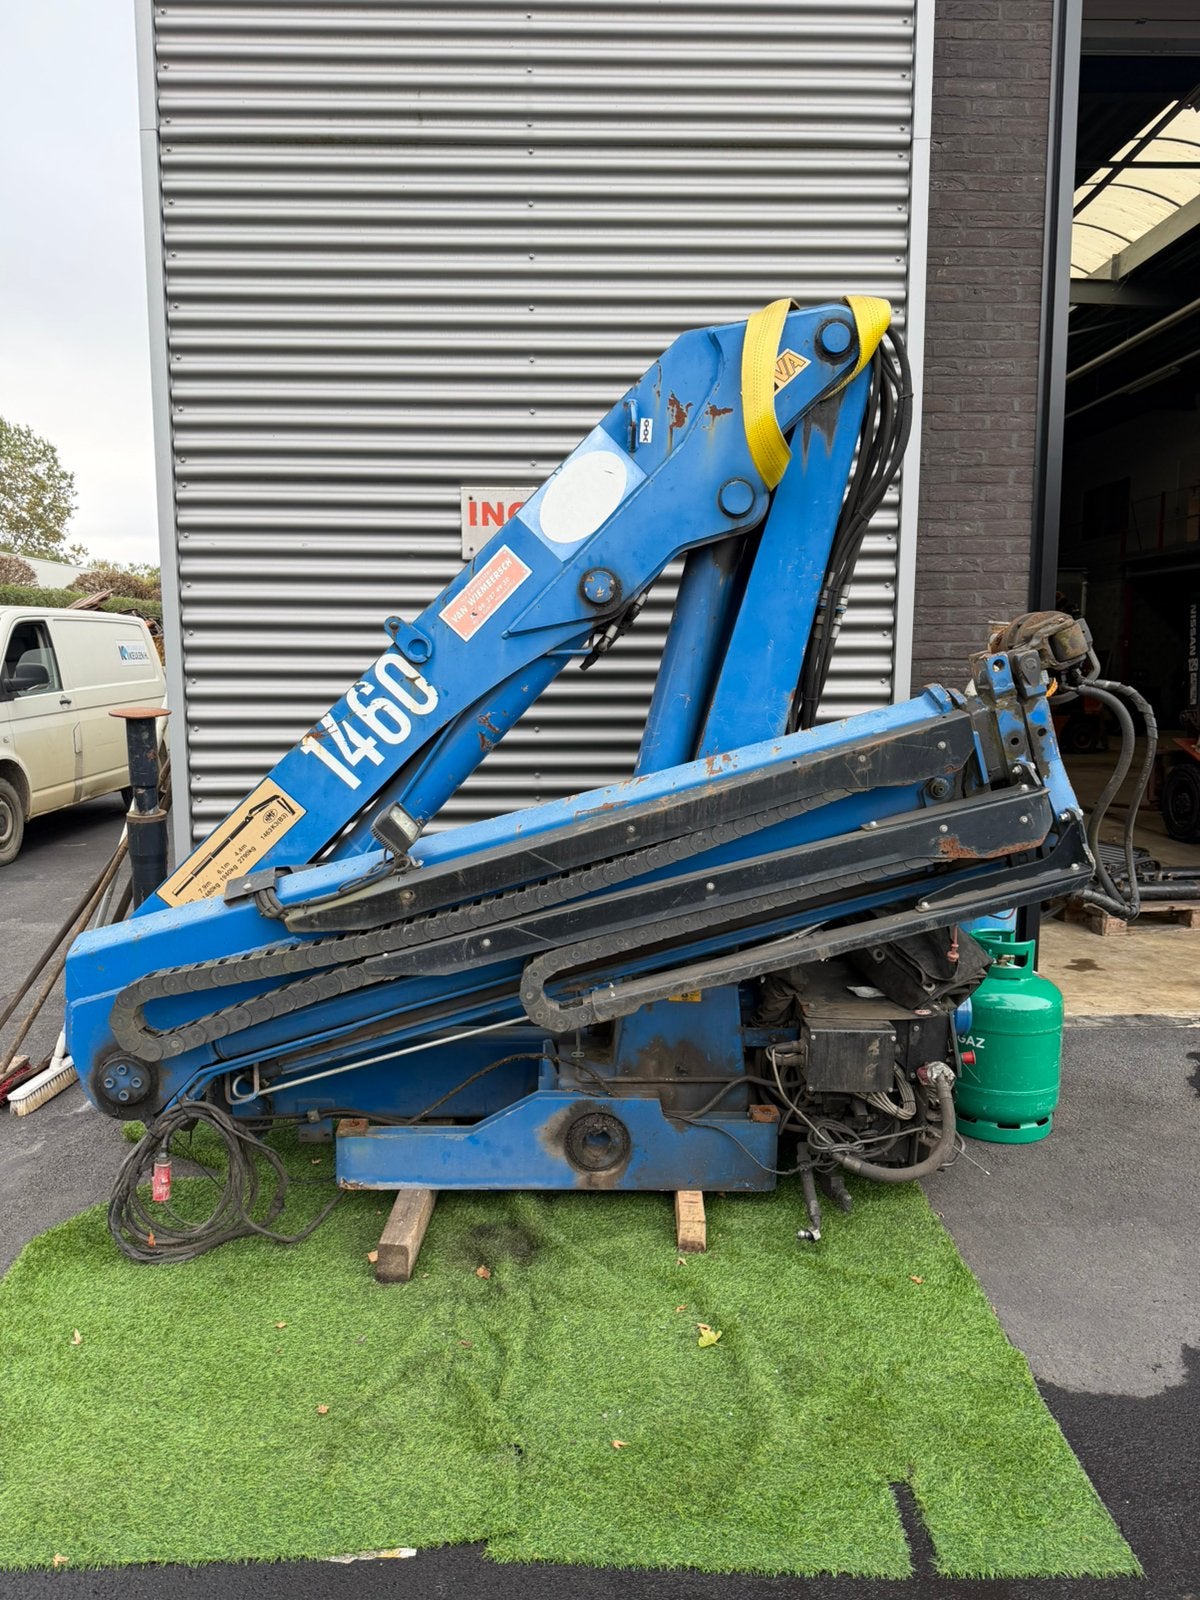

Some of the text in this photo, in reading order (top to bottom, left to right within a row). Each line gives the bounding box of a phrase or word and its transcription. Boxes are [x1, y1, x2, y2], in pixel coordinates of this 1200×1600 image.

[452, 605, 468, 622] VAN
[467, 558, 512, 606] WIEMEERSCH
[1189, 604, 1197, 656] NISSAN
[300, 653, 438, 790] 1460
[264, 809, 277, 823] HMF
[234, 844, 247, 857] 4,4m
[957, 1035, 985, 1049] GAZ
